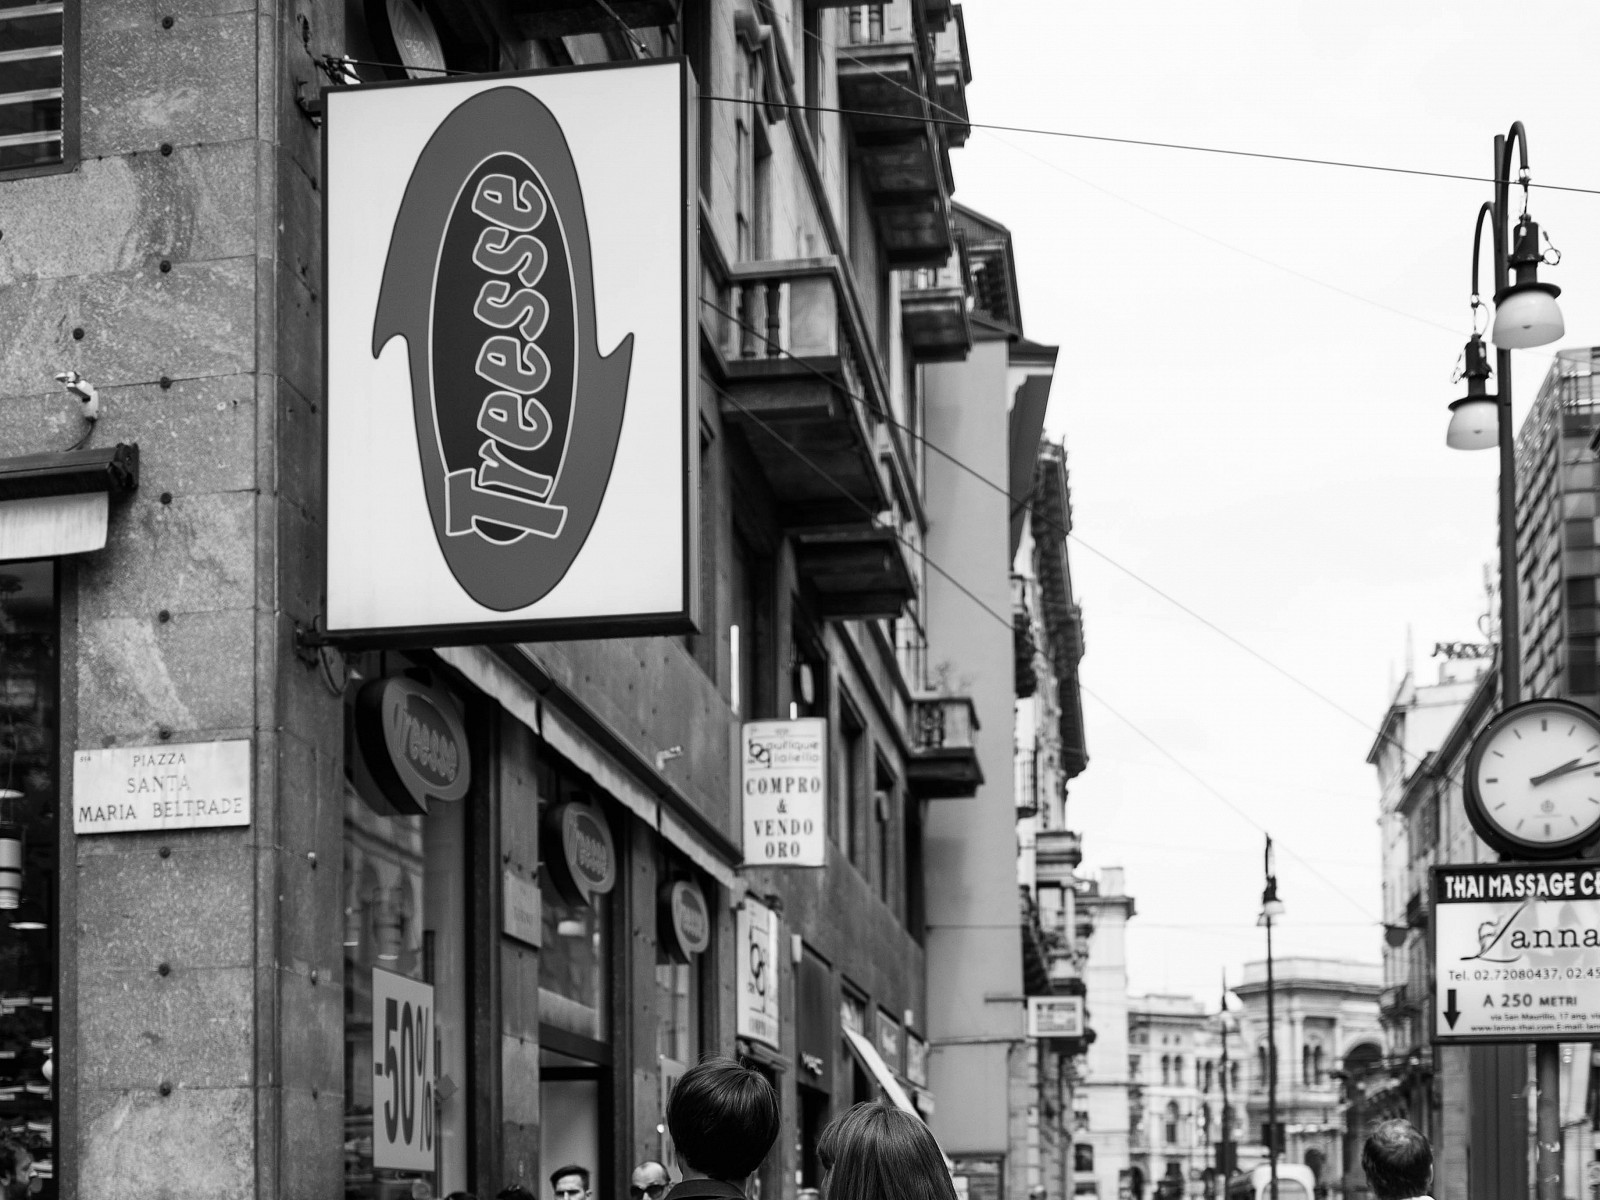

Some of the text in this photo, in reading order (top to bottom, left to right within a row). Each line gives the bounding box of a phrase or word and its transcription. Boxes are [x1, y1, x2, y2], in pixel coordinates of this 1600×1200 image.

[445, 174, 568, 538] Treesse
[133, 753, 187, 767] PIAZZA
[127, 775, 191, 793] SANTA
[746, 777, 820, 795] COMPRO
[78, 797, 243, 823] MARIA BELTRADE
[776, 798, 787, 814] &
[754, 819, 813, 836] VENDO
[765, 841, 800, 858] ORO
[1445, 874, 1485, 899] THAI
[1488, 871, 1576, 897] MASSAGE
[1448, 970, 1470, 981] Tel.
[1482, 993, 1577, 1008] A 250 METRI
[374, 997, 432, 1152] -50%
